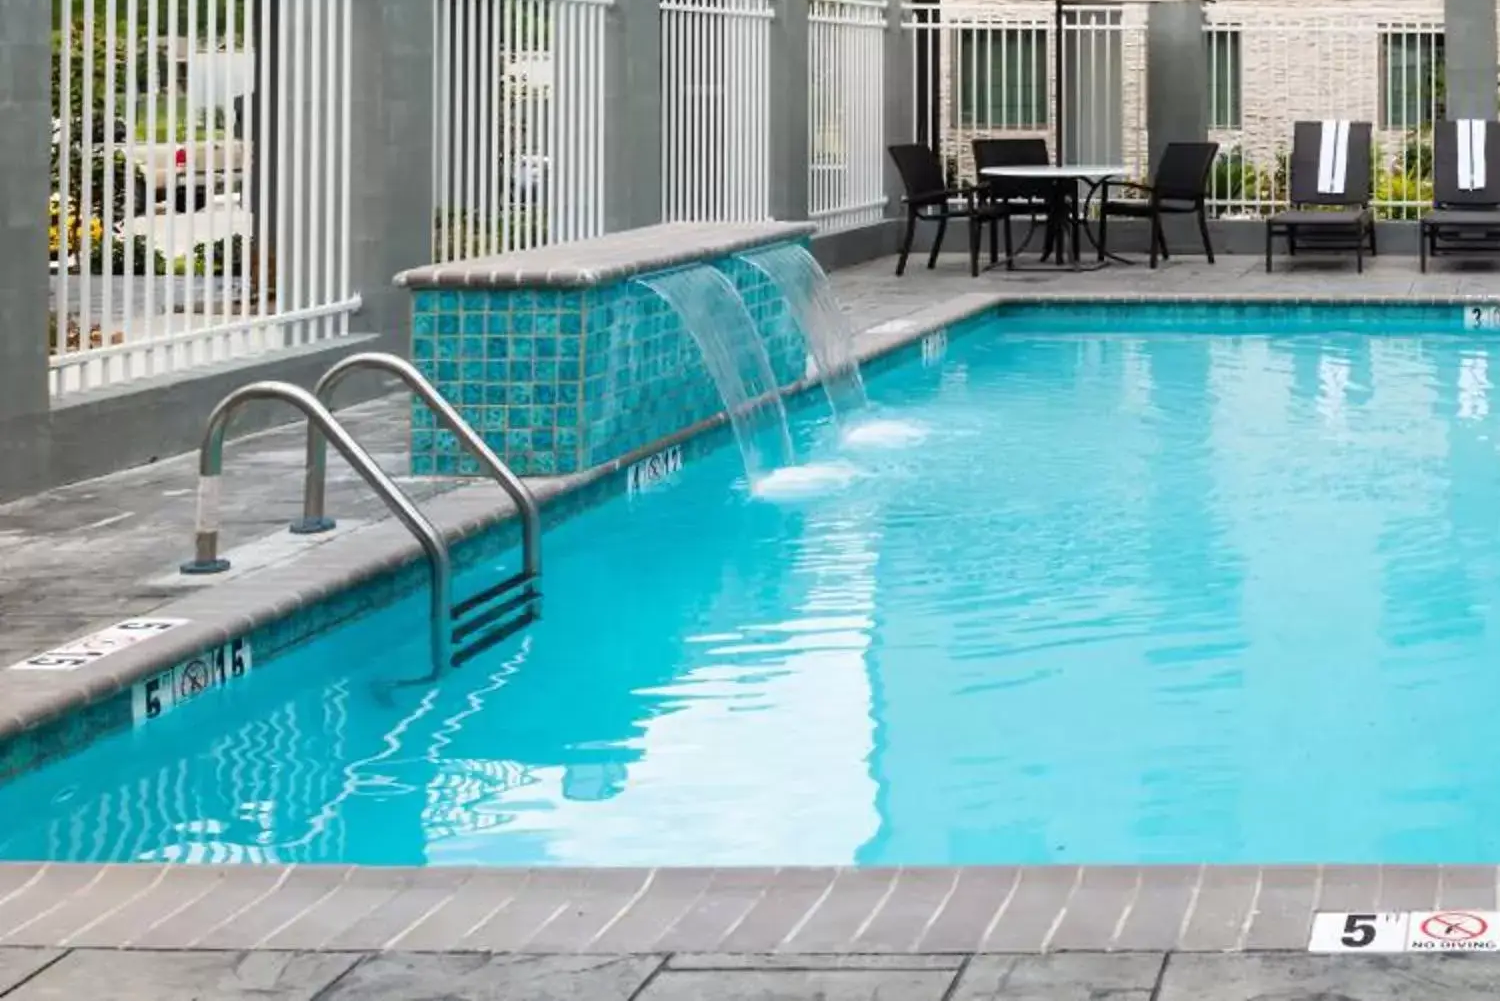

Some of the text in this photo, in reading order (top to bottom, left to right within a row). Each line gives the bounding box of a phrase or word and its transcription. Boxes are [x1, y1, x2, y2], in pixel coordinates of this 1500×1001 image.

[1341, 914, 1377, 948] 5
[1412, 940, 1497, 948] NO DIVING
